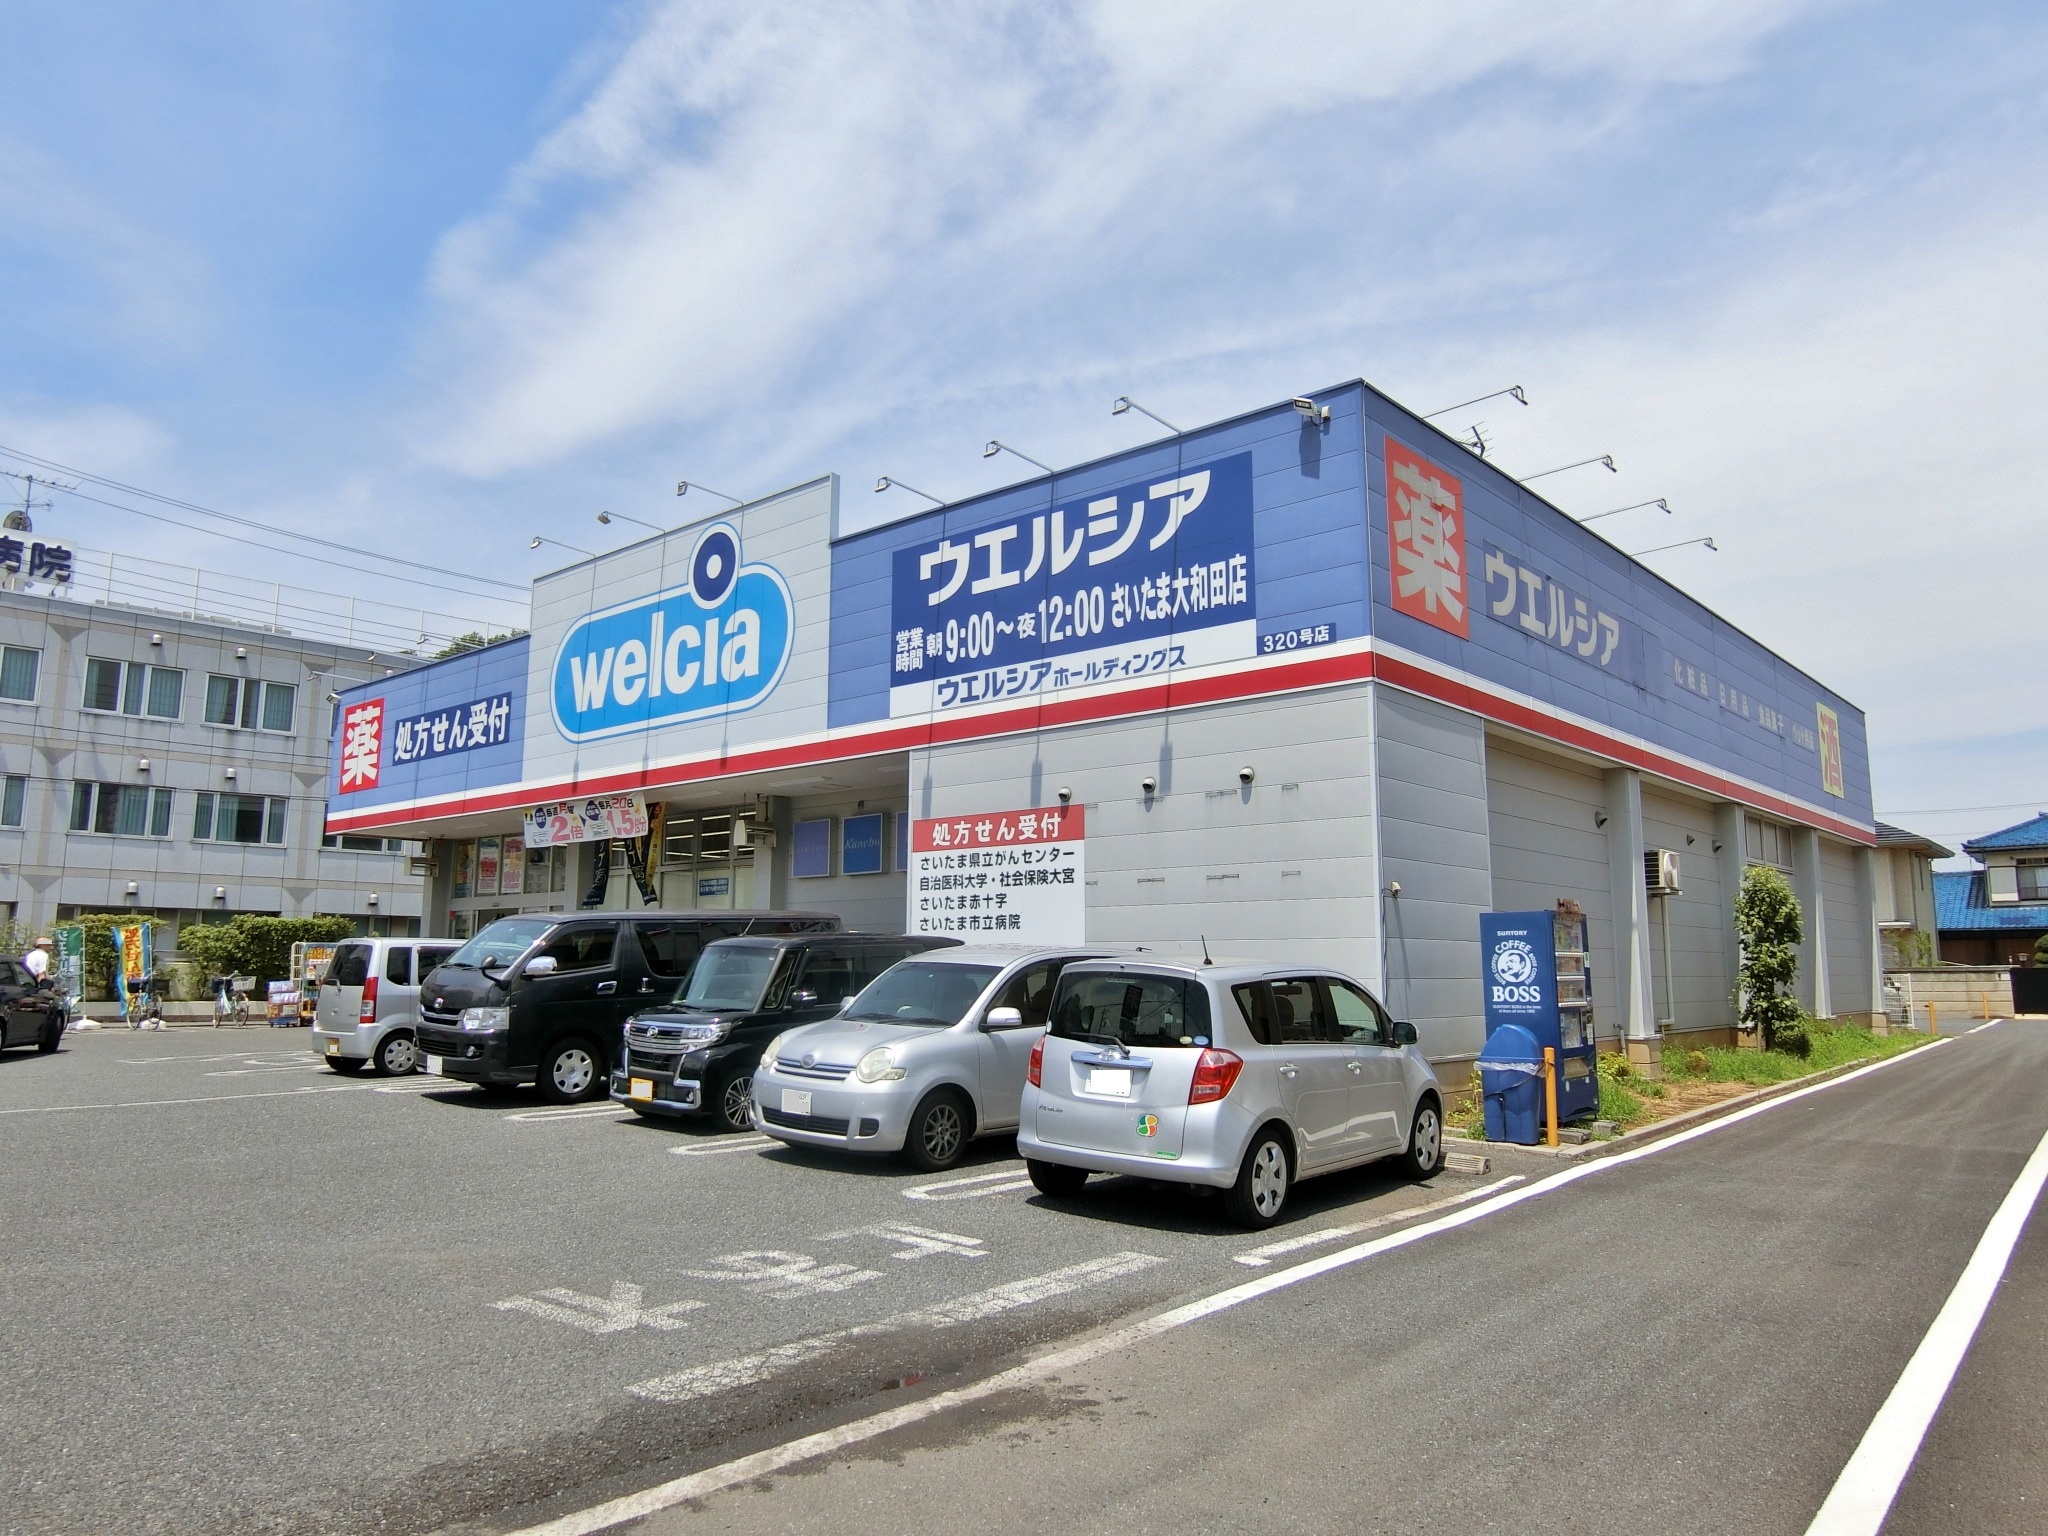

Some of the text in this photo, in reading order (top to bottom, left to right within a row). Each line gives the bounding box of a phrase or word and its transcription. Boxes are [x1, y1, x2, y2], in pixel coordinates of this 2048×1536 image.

[920, 469, 1210, 606] ウエルシア
[1393, 462, 1464, 623] 薬
[1111, 553, 1246, 628] さいたま大和田店
[1484, 549, 1620, 666] ウエルシア
[570, 606, 760, 712] welcia
[1263, 625, 1329, 652] 320号店
[342, 704, 381, 786] 薬
[395, 699, 510, 764] 処方せん受付
[1820, 710, 1841, 791] 酒
[920, 847, 1075, 871] さいたま県立がんセンター
[932, 812, 1061, 847] 処方せん受付
[919, 893, 1008, 911] さいたま赤十字
[919, 914, 1021, 932] さいたま市立病院
[1495, 940, 1532, 953] COFFEE
[1492, 986, 1540, 1002] BOSS
